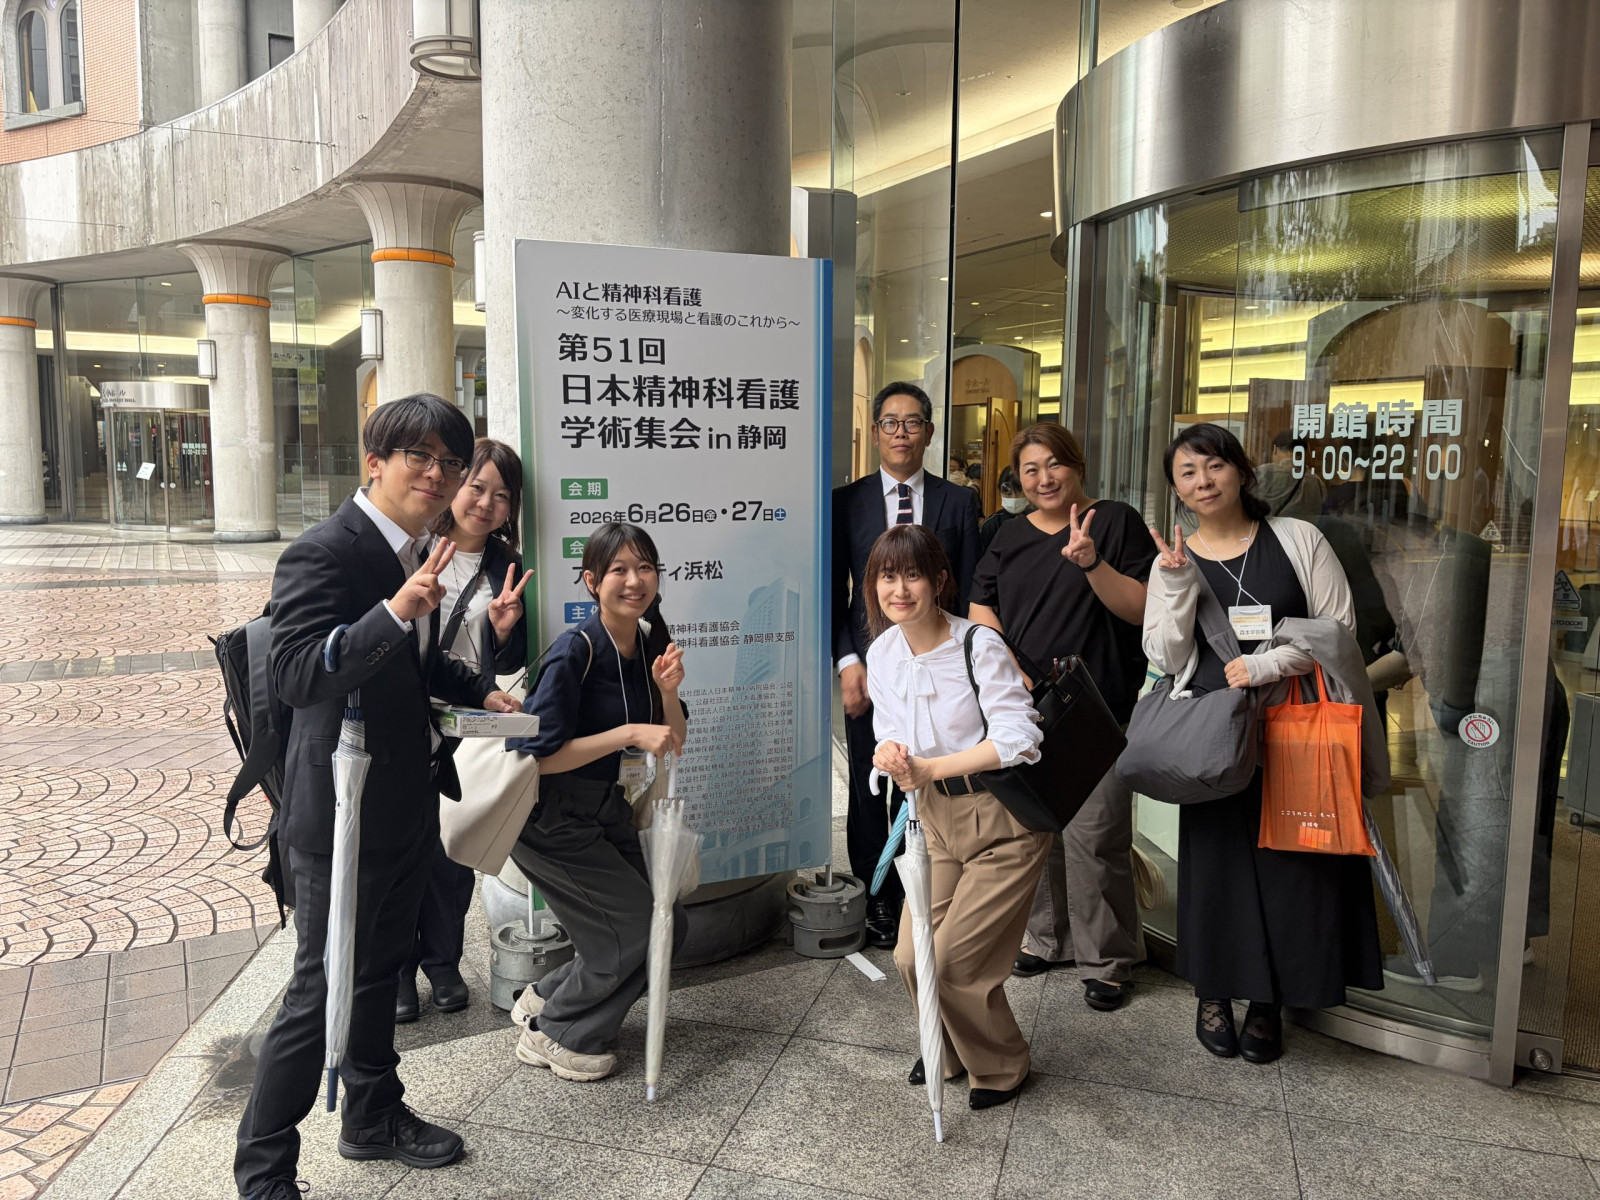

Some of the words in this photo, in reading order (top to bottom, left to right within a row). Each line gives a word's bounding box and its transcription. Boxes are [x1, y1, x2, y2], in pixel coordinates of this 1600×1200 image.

[556, 281, 702, 307] AIと精神科看護
[558, 332, 666, 365] 第51回
[562, 373, 800, 410] 日本精神科看護
[560, 415, 702, 449] 学術集会
[708, 426, 731, 450] in
[737, 424, 787, 450] 静岡
[1292, 399, 1463, 440] 開館時間
[568, 482, 602, 496] 会期
[673, 635, 740, 649] 神科看護協会
[743, 631, 795, 645] 静岡県支部
